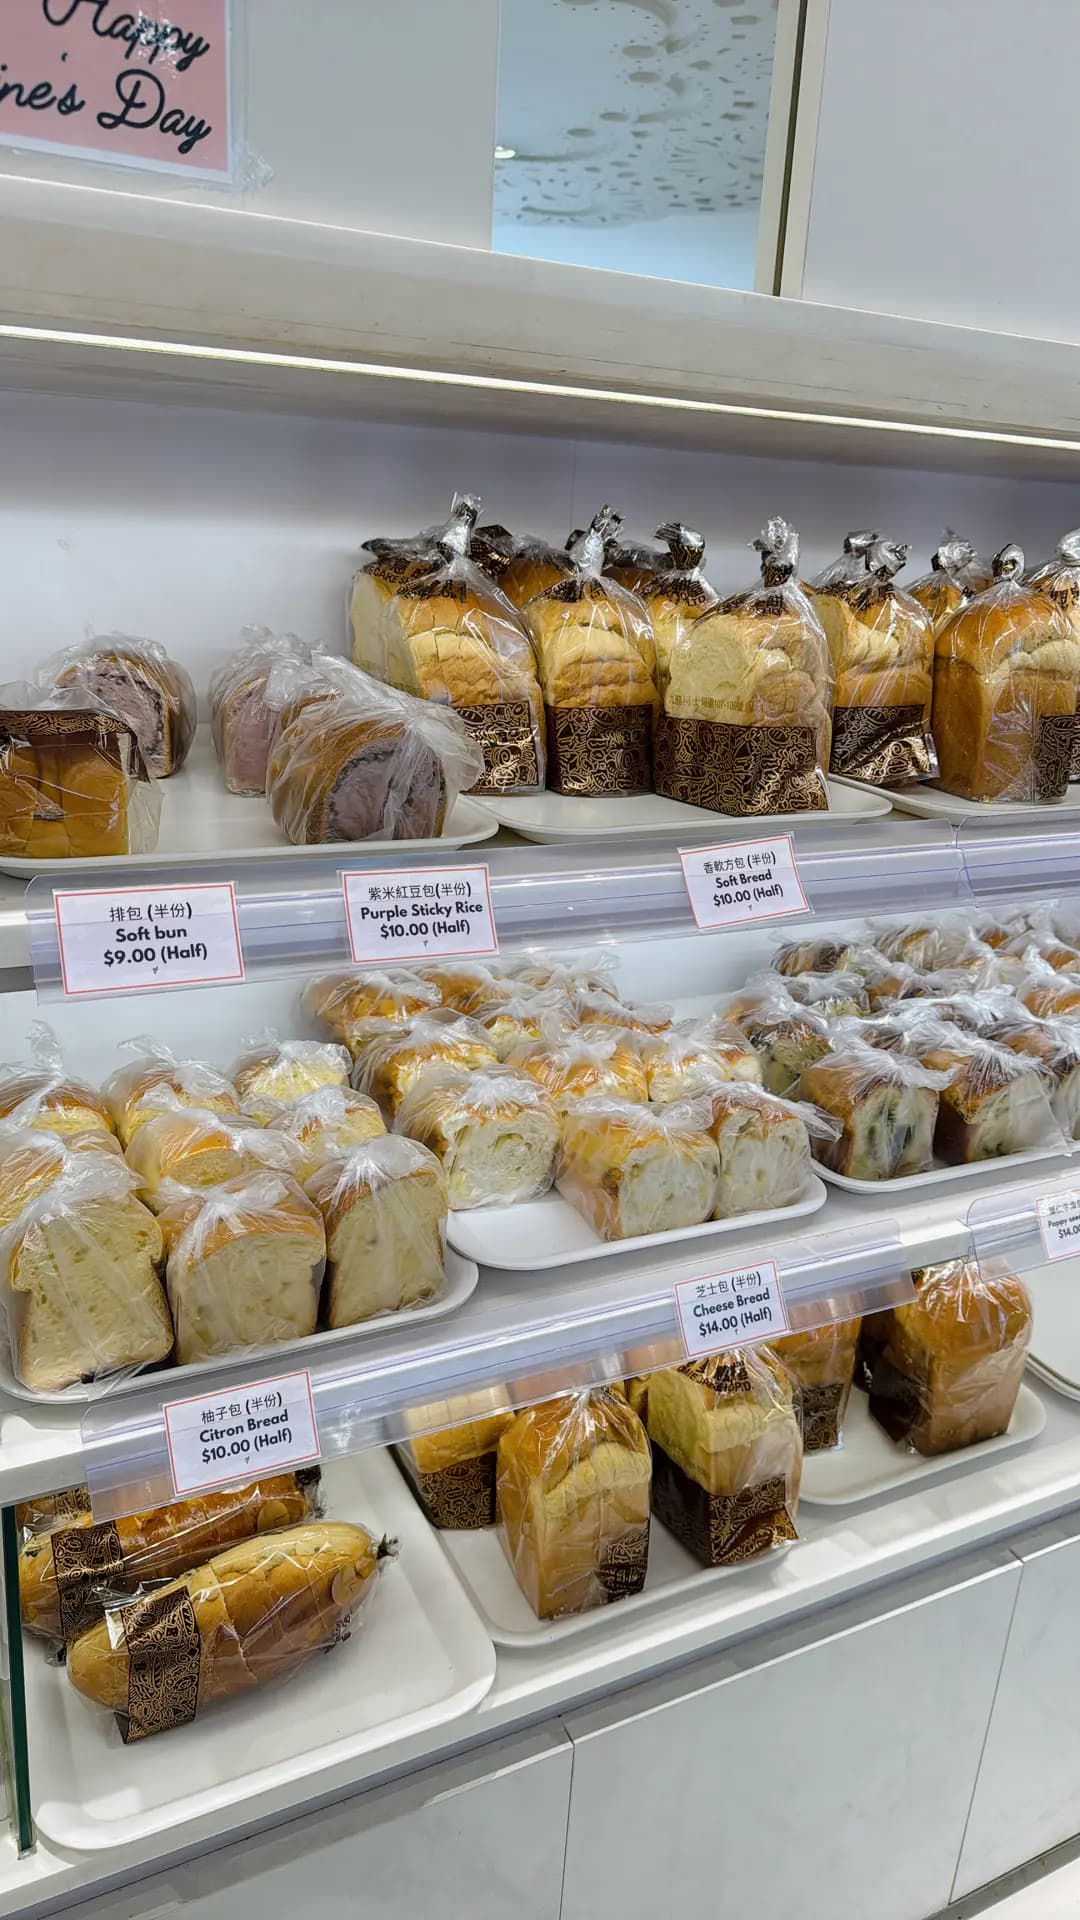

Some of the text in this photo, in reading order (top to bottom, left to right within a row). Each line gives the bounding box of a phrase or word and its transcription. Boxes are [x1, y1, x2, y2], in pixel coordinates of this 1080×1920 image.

[97, 69, 212, 154] Day
[747, 850, 776, 869] (半份)
[368, 881, 472, 901] 紫米紅豆包(半份)
[715, 868, 773, 889] Soft Bread
[713, 884, 784, 908] $10.00 (Half)
[109, 901, 192, 922] 排包 (半份)
[360, 901, 483, 922] Purple Sticky Rice
[115, 925, 188, 943] Soft bun
[380, 919, 470, 940] $10.00 (Half)
[103, 942, 208, 968] $9.00 (Half)
[695, 1271, 761, 1299] 芝士包 (半份)
[693, 1287, 771, 1318] Cheese Bread
[699, 1306, 772, 1338] $14.00 (Half)
[201, 1391, 282, 1425] 柚子包 (半份)
[199, 1408, 289, 1443] Citron Bread
[202, 1427, 292, 1464] $10.00 (Half)
